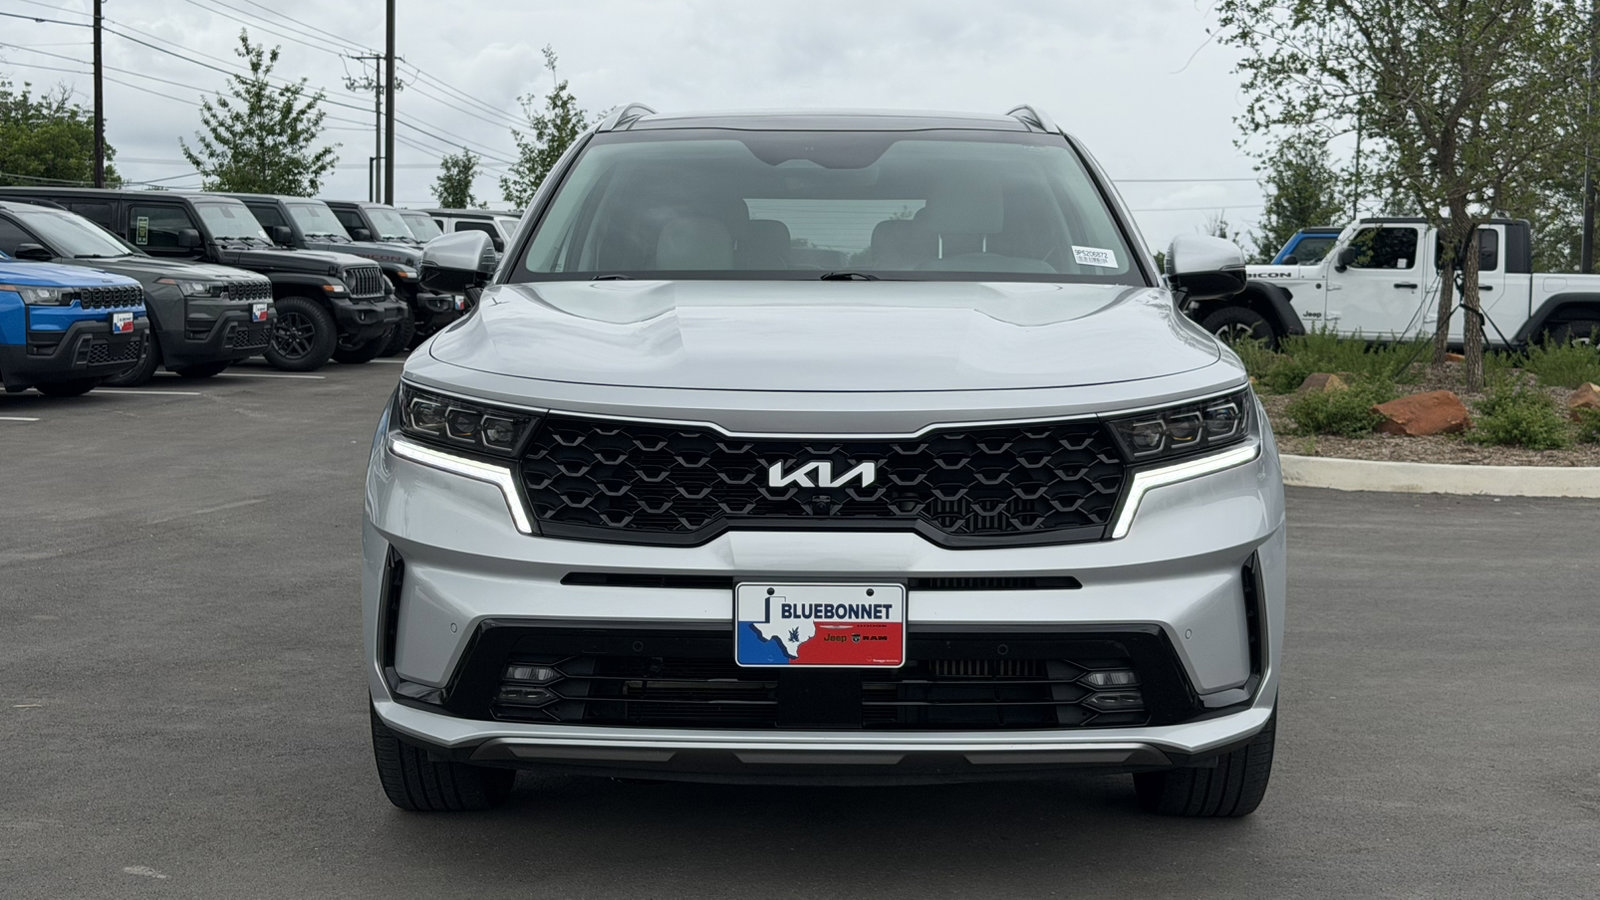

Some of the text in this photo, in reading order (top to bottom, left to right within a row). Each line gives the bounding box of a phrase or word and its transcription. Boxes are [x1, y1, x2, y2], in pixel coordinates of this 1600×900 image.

[1303, 310, 1322, 318] Jeep
[768, 461, 876, 488] KIA
[781, 603, 893, 619] BLUEBONNET
[823, 633, 847, 642] Jeep
